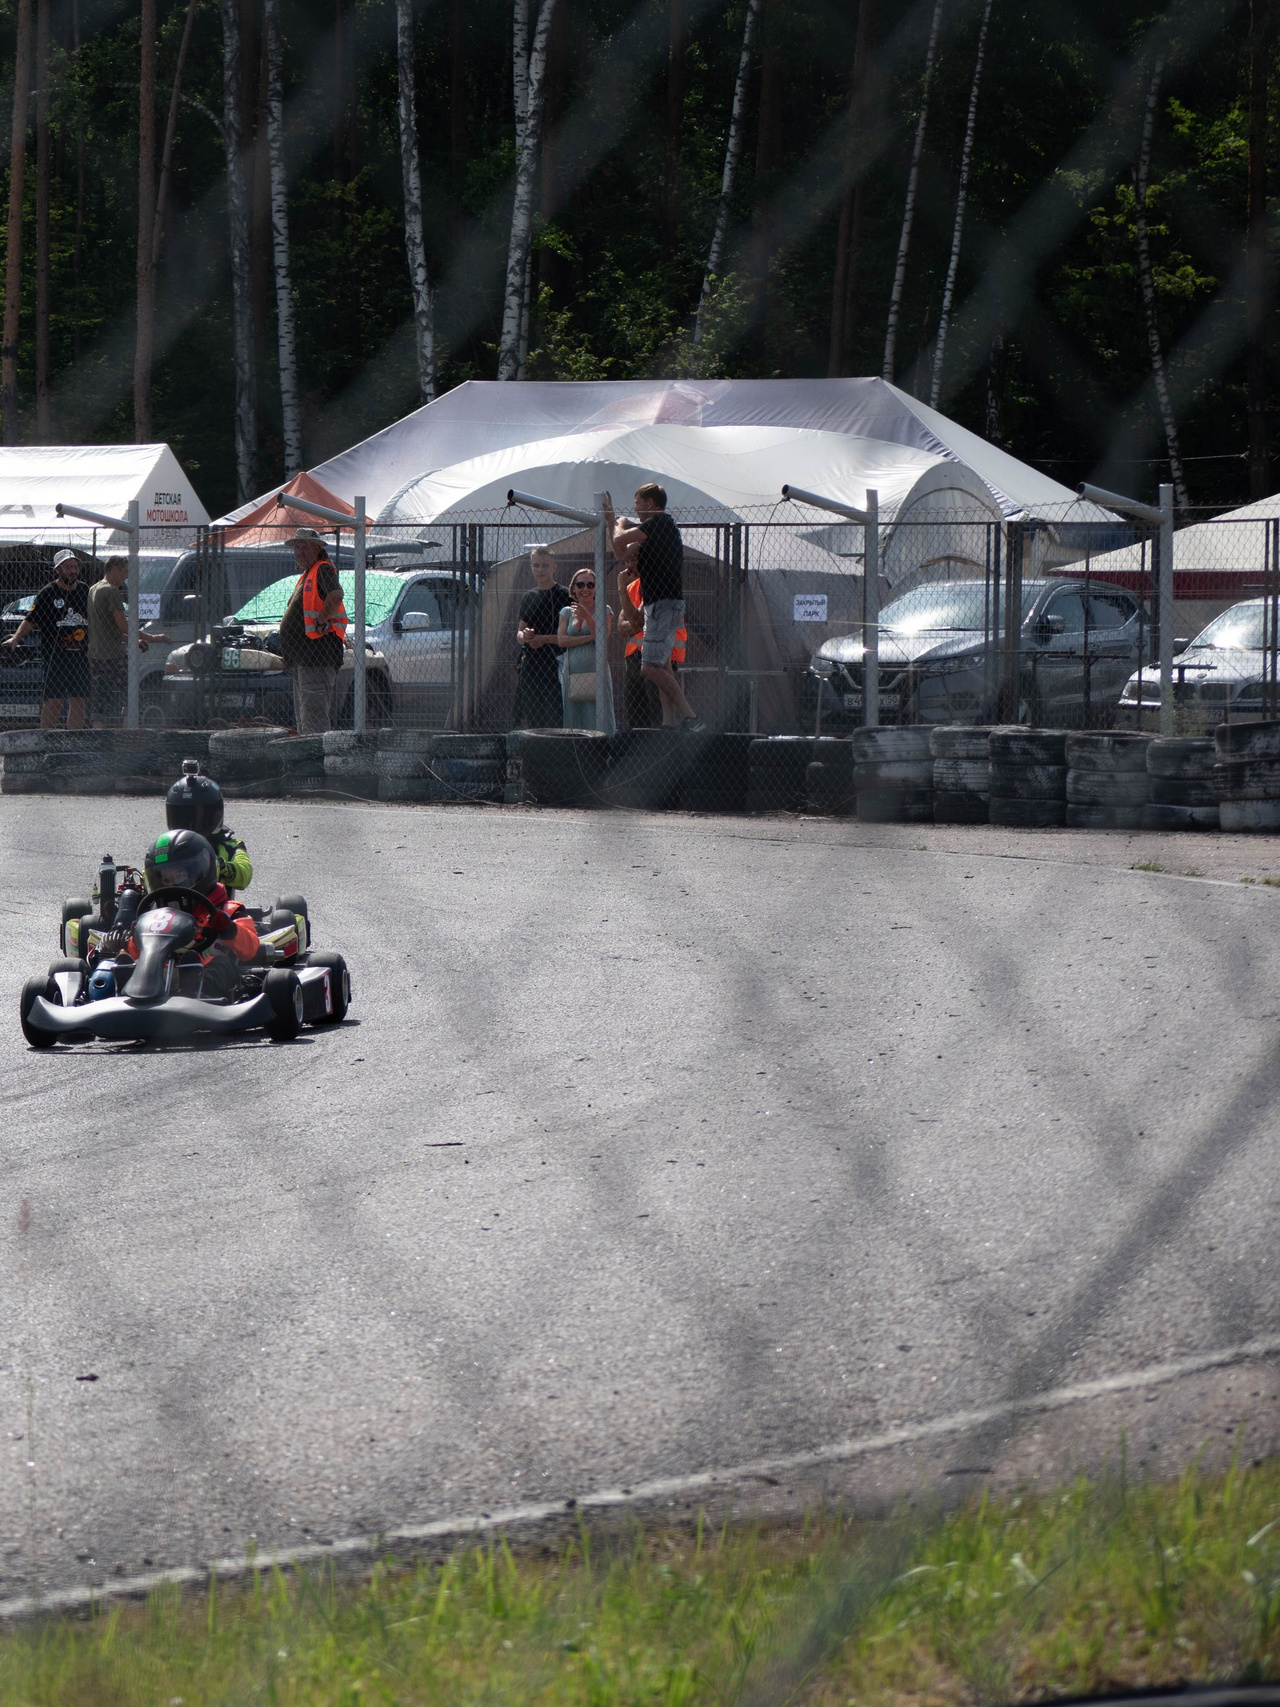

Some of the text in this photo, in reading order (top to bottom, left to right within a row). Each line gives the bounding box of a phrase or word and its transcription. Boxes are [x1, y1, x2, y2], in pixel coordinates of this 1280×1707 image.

[154, 493, 181, 506] ДЕТСКАЯ
[147, 510, 188, 522] МОТОШКОЛА
[150, 912, 173, 931] 3
[324, 974, 331, 1013] 3
